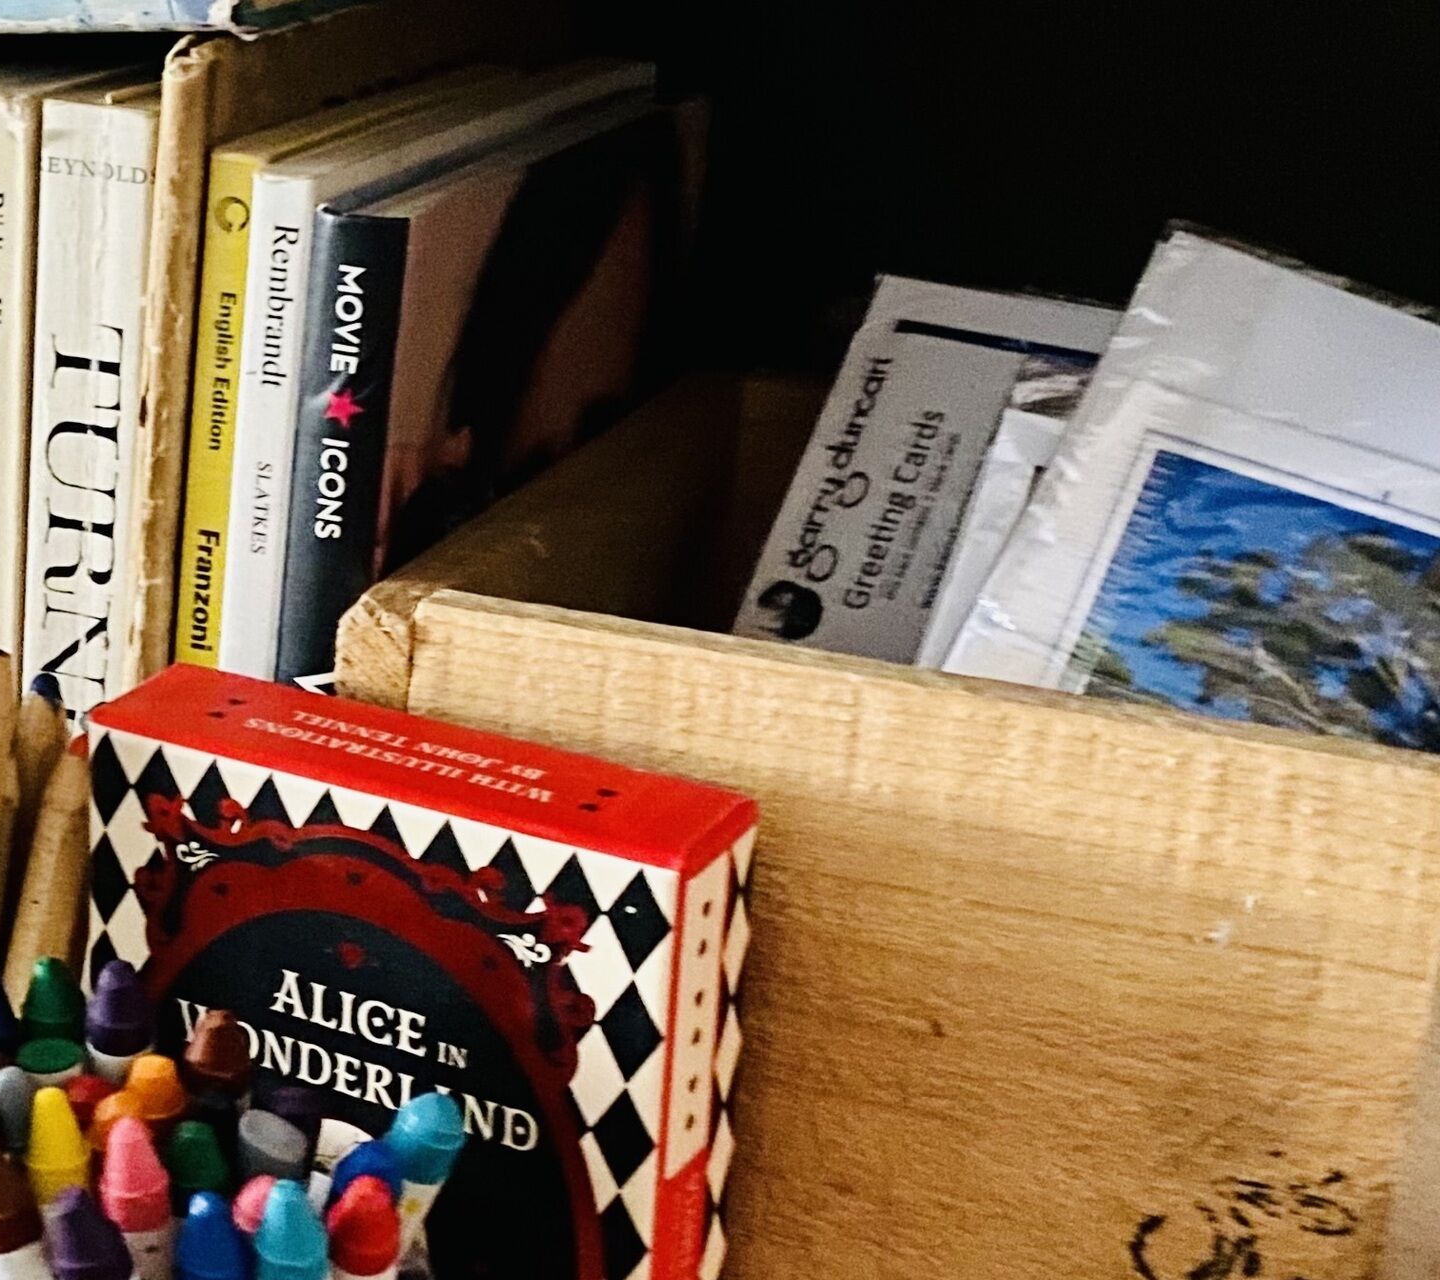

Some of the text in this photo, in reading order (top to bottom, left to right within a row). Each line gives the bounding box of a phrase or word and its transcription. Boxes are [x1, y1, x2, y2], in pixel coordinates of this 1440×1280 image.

[46, 156, 155, 185] EYNOLD
[260, 224, 301, 386] Rembrandt
[206, 291, 238, 452] English Edition
[314, 262, 367, 541] MOVIE ICONS
[825, 356, 894, 470] duncan
[39, 322, 125, 720] TURN
[250, 460, 274, 556] SLATKES
[843, 491, 917, 610] Greeting
[892, 410, 946, 485] Cards
[189, 528, 221, 652] Franzoni
[244, 717, 557, 803] WITH ILLUSTRATIONS
[292, 710, 550, 781] BY JOHN TENNIEL
[176, 997, 540, 1153] WNDERLND
[269, 968, 470, 1070] ALICE IN
